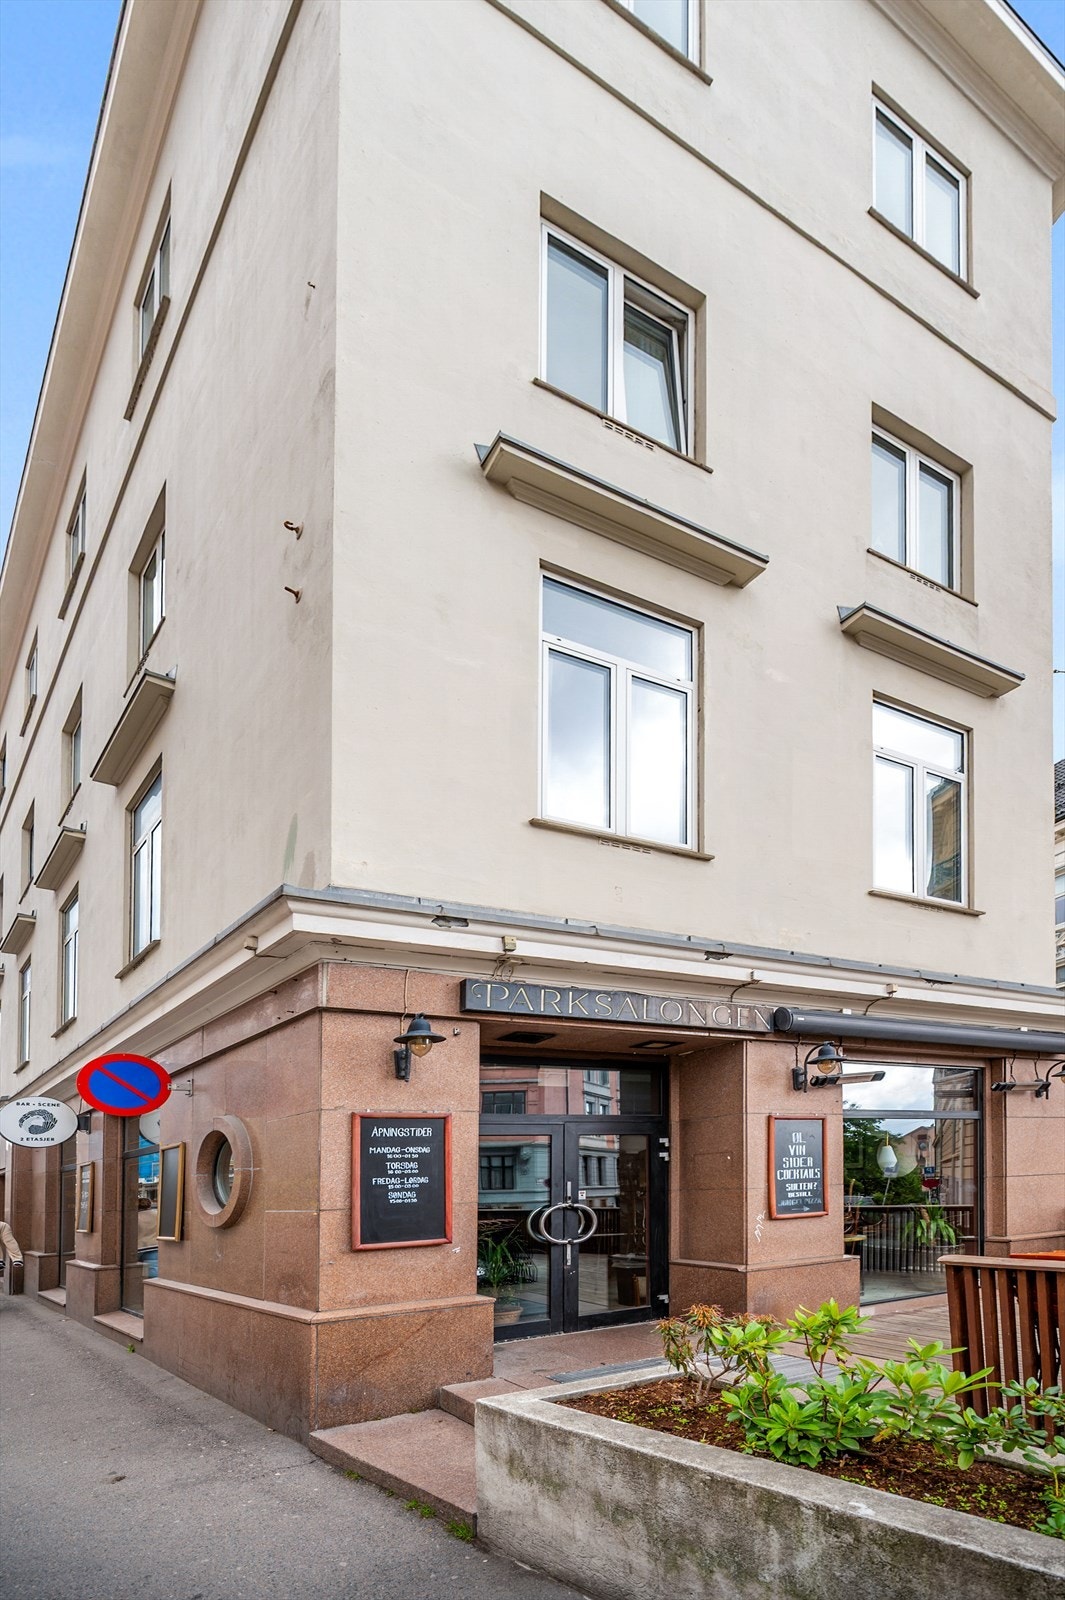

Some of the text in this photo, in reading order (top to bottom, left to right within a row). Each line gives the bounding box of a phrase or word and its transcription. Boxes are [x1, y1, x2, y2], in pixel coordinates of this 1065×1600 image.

[471, 982, 771, 1031] PARKSALONGEN
[371, 1126, 432, 1137] ÅPNINGSTIDER
[792, 1132, 806, 1143] ØL
[788, 1145, 806, 1156] VIN
[385, 1162, 418, 1170] TORSDAG
[782, 1157, 813, 1168] SIDER
[777, 1168, 820, 1180] COCKTAILS
[786, 1182, 817, 1191] SULTEN?
[388, 1191, 416, 1199] SØNDAG
